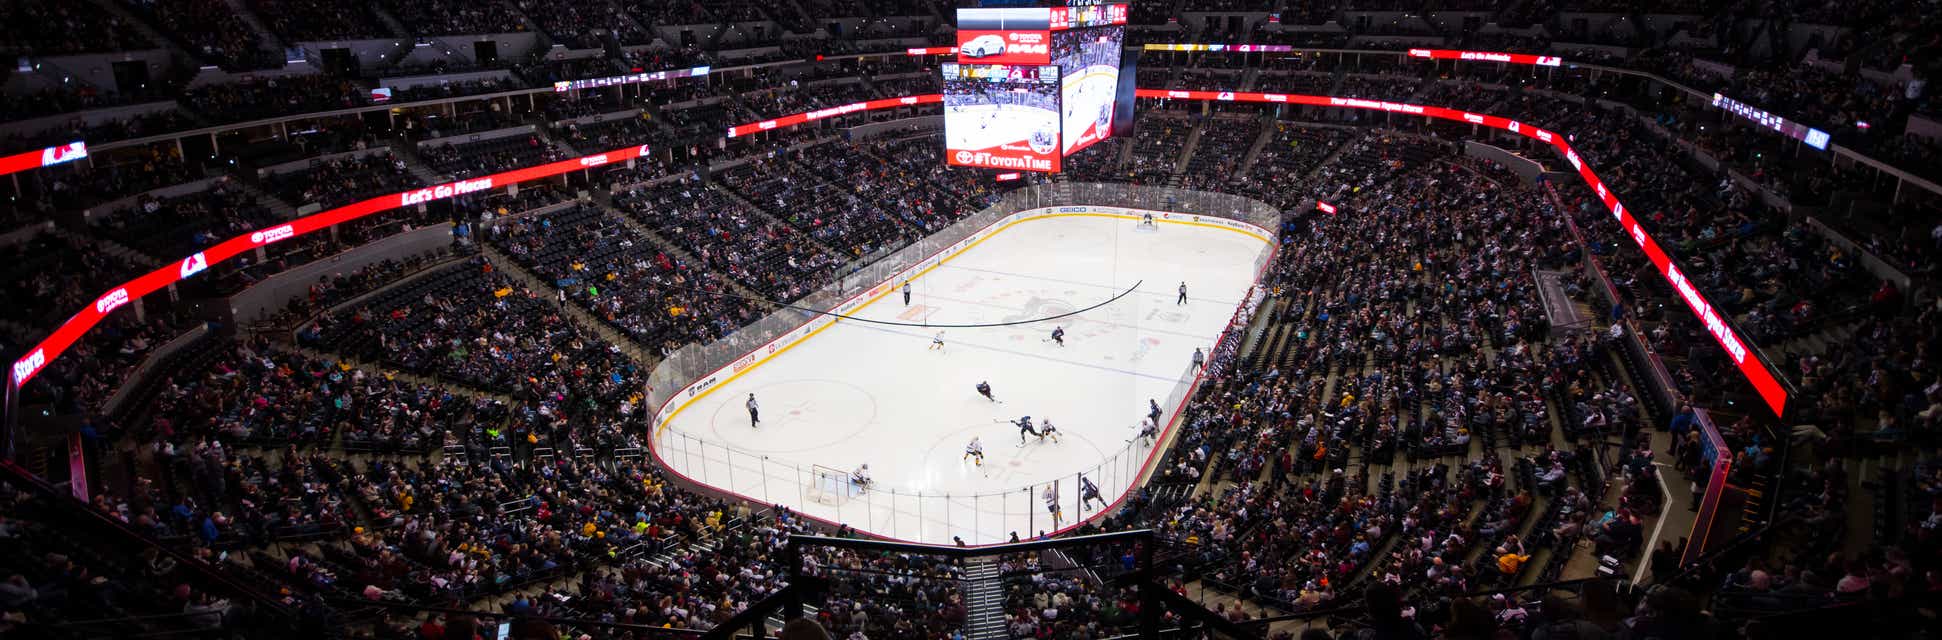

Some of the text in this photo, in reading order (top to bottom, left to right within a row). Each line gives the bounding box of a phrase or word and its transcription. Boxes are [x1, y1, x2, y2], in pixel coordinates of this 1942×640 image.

[402, 179, 492, 206] Let's Go Places
[263, 225, 293, 240] TOYOTA
[14, 348, 45, 383] Stores
[697, 377, 716, 391] RAM
